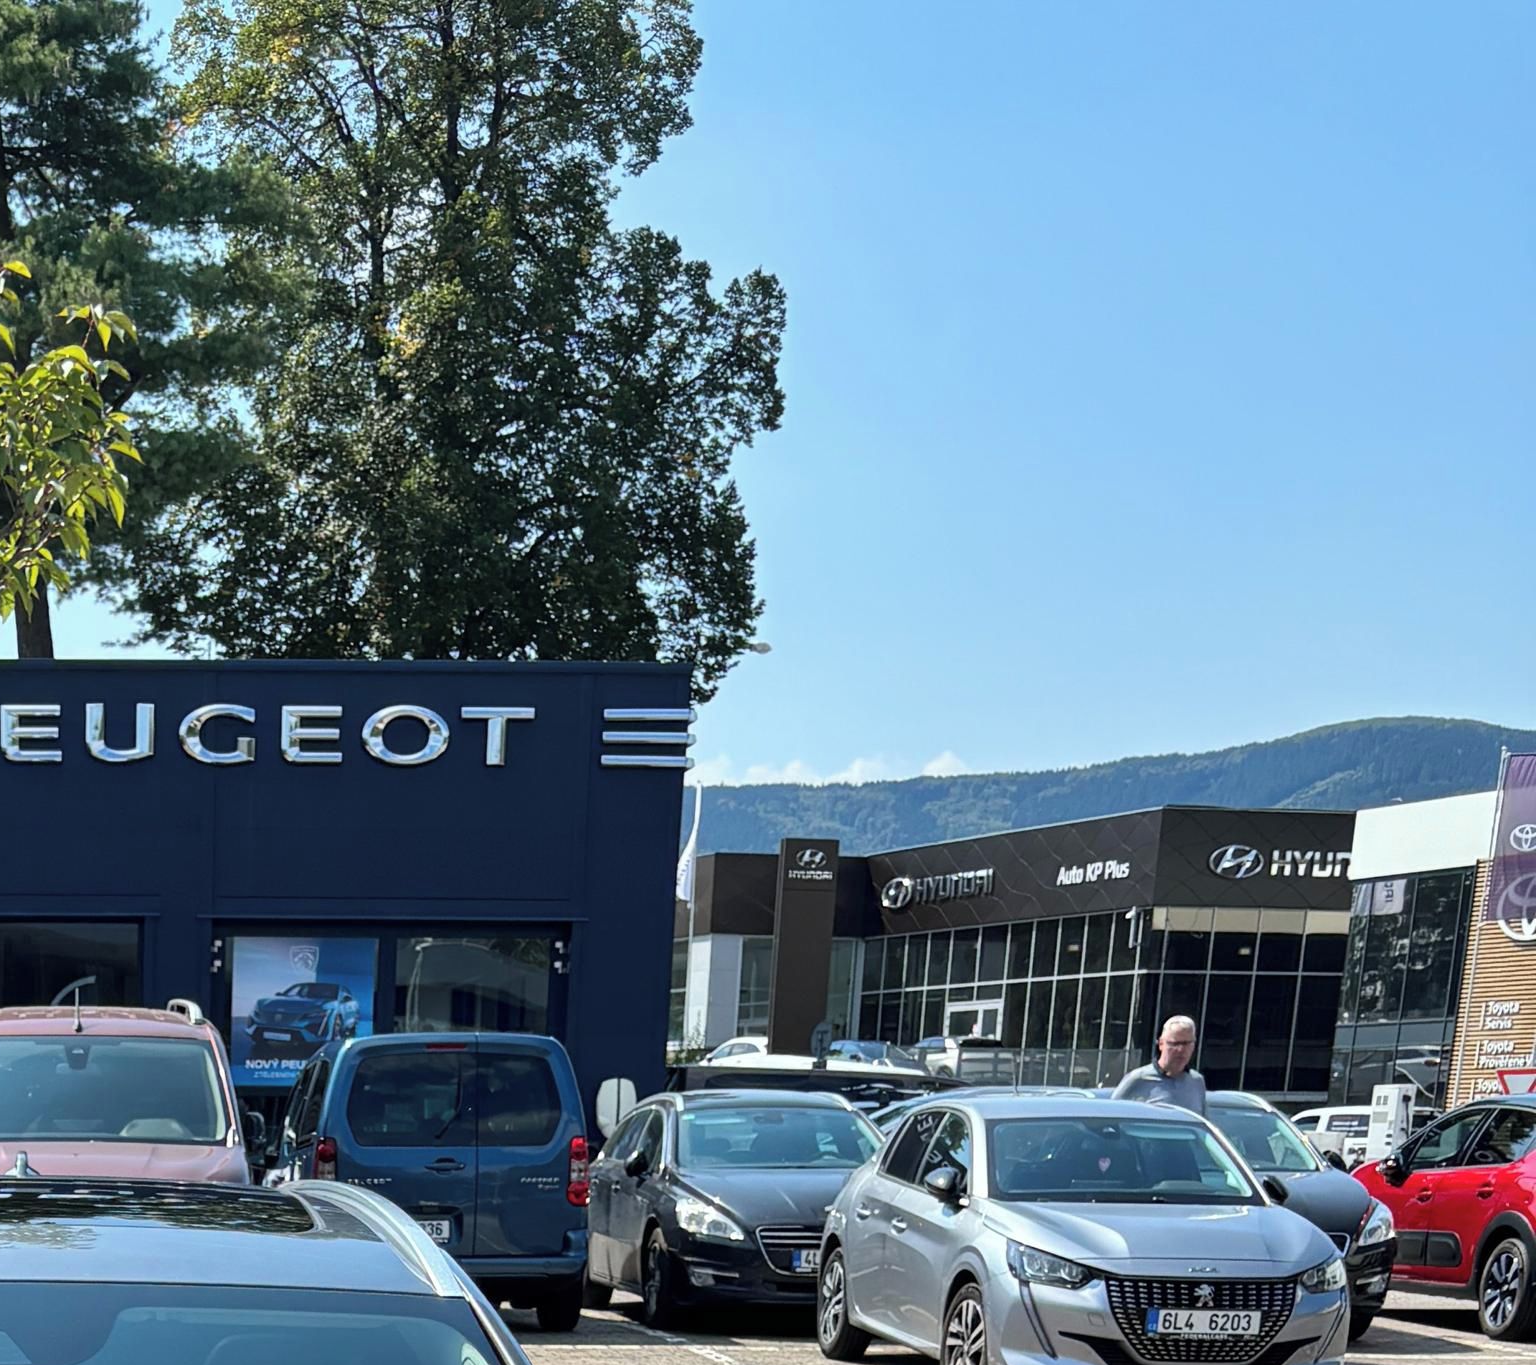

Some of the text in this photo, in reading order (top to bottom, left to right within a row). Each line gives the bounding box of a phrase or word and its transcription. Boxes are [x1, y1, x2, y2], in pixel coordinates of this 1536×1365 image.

[1270, 850, 1352, 877] HYUN
[788, 869, 833, 881] HYUNDAI
[1056, 859, 1130, 886] Auto KP Plus
[915, 868, 994, 904] HYUNDAI
[1484, 1001, 1520, 1016] Toyota
[1480, 1040, 1514, 1055] Toyota
[245, 1057, 280, 1070] NOVÝ
[1162, 1312, 1252, 1332] 6L4 6203
